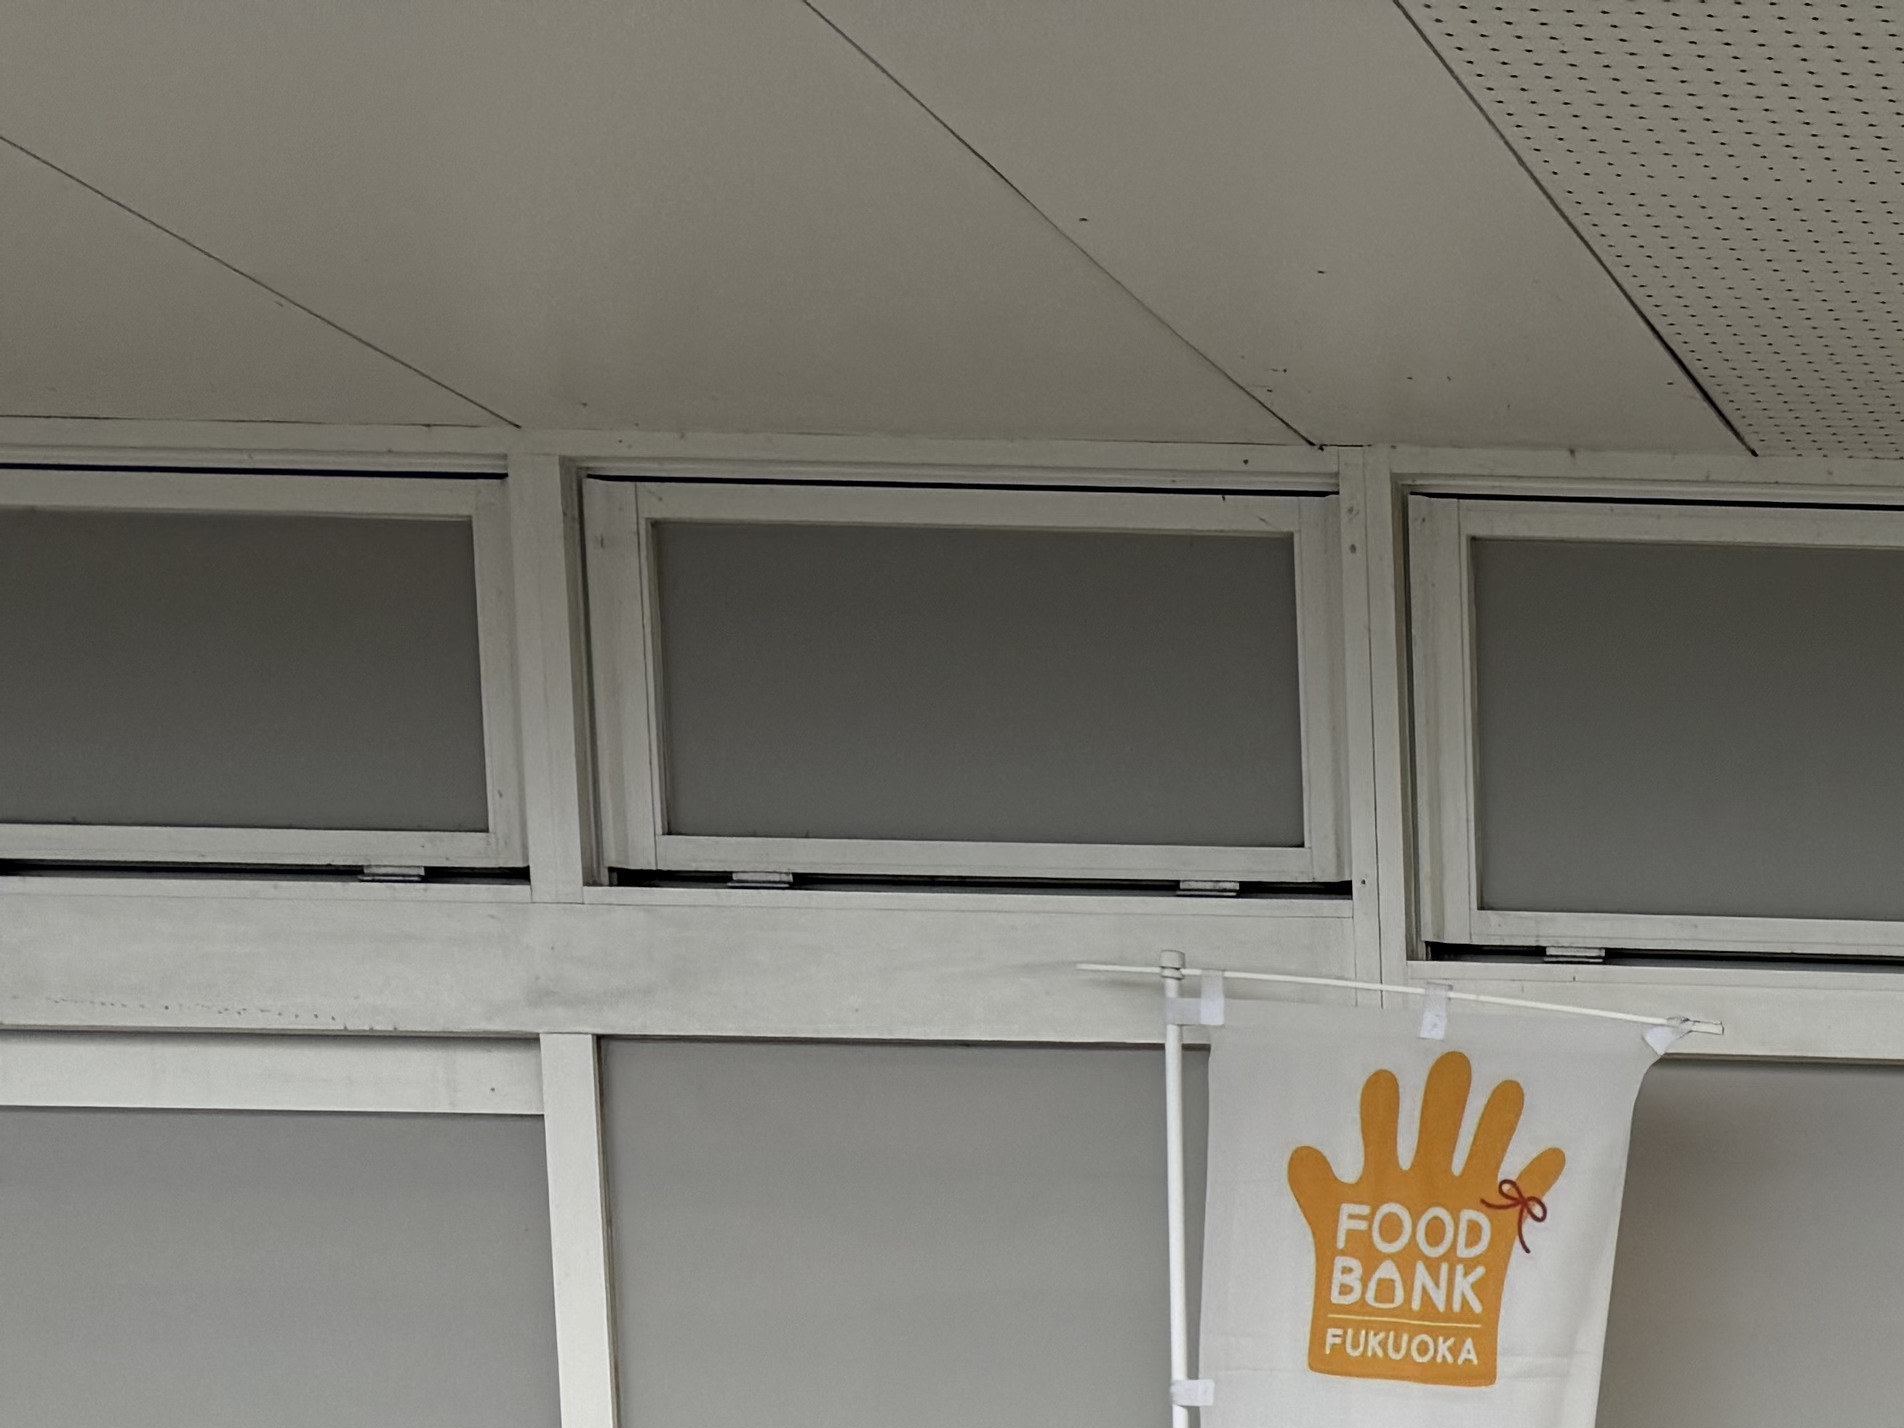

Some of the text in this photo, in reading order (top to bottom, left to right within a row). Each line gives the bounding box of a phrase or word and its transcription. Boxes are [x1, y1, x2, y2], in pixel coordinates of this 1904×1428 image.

[1336, 1202, 1491, 1260] FOOD
[1330, 1256, 1487, 1315] BANK
[1325, 1327, 1479, 1366] FUKUOKA
